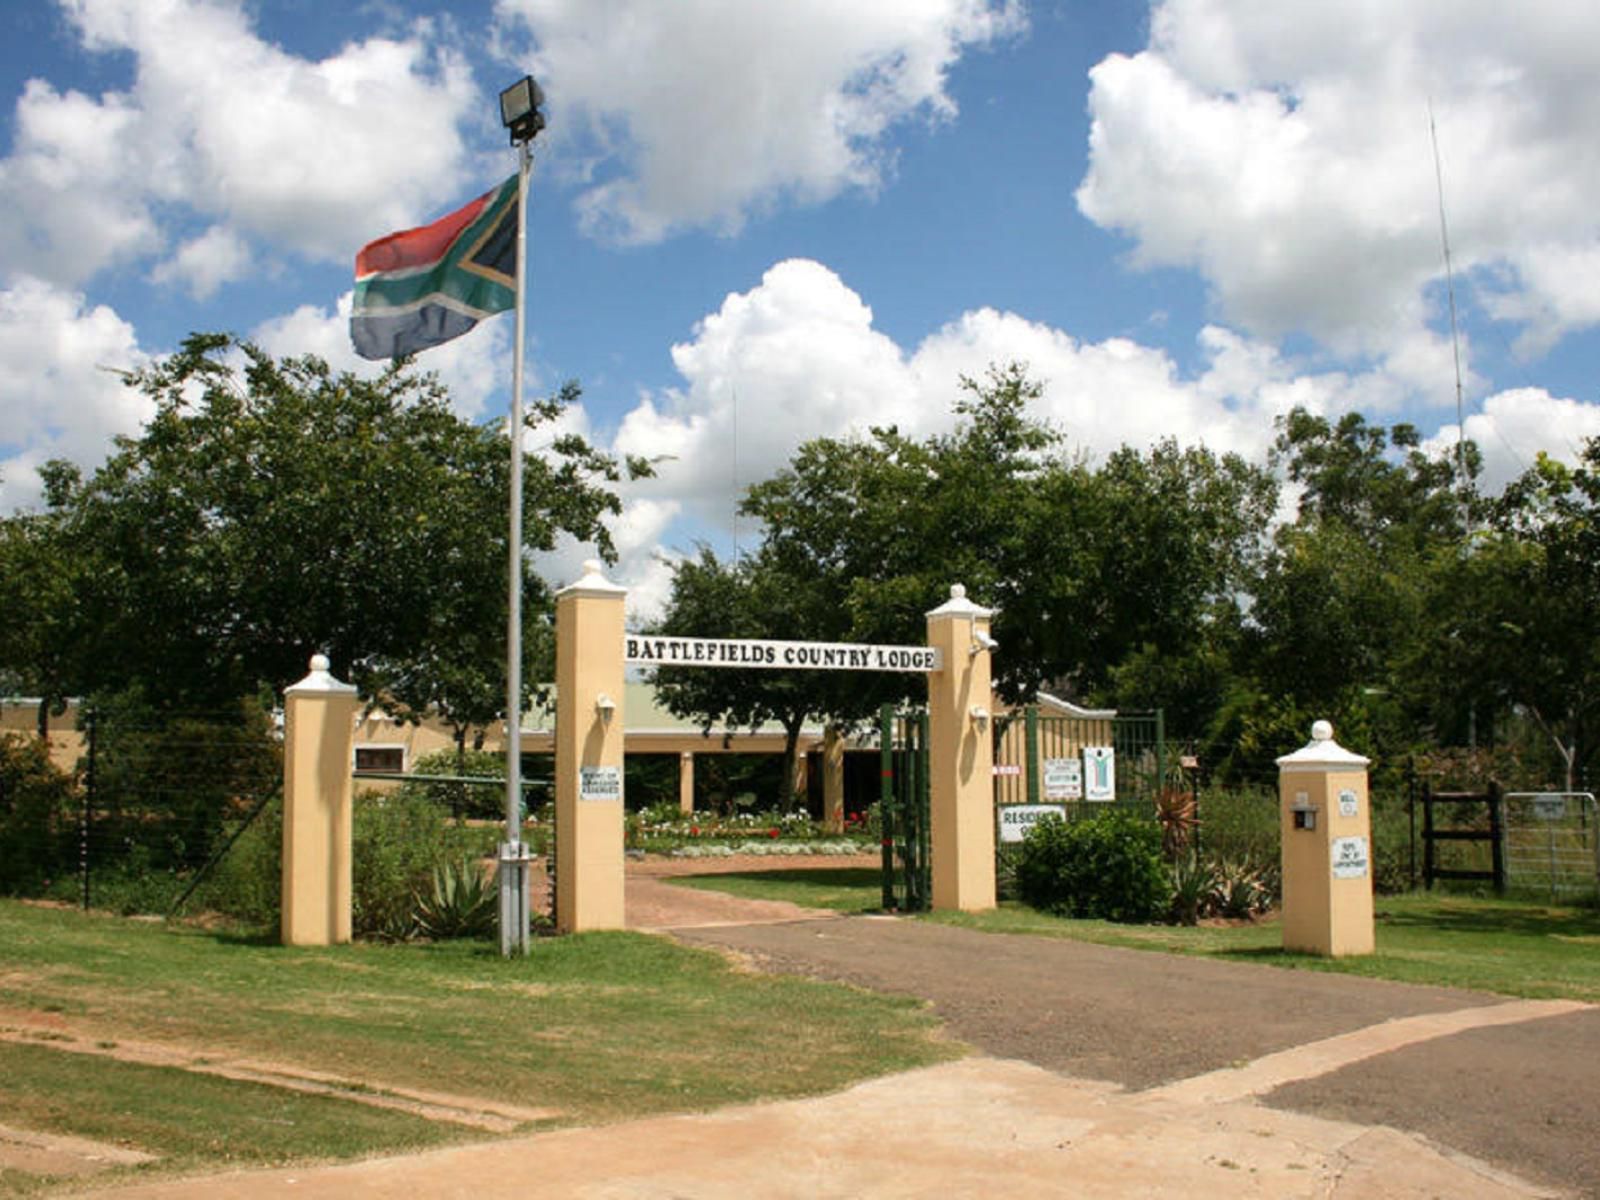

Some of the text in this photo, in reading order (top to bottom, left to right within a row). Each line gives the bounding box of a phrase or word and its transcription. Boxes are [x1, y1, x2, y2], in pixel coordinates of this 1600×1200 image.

[627, 640, 934, 668] BATTLEFIELDS COUNTRY LODGE
